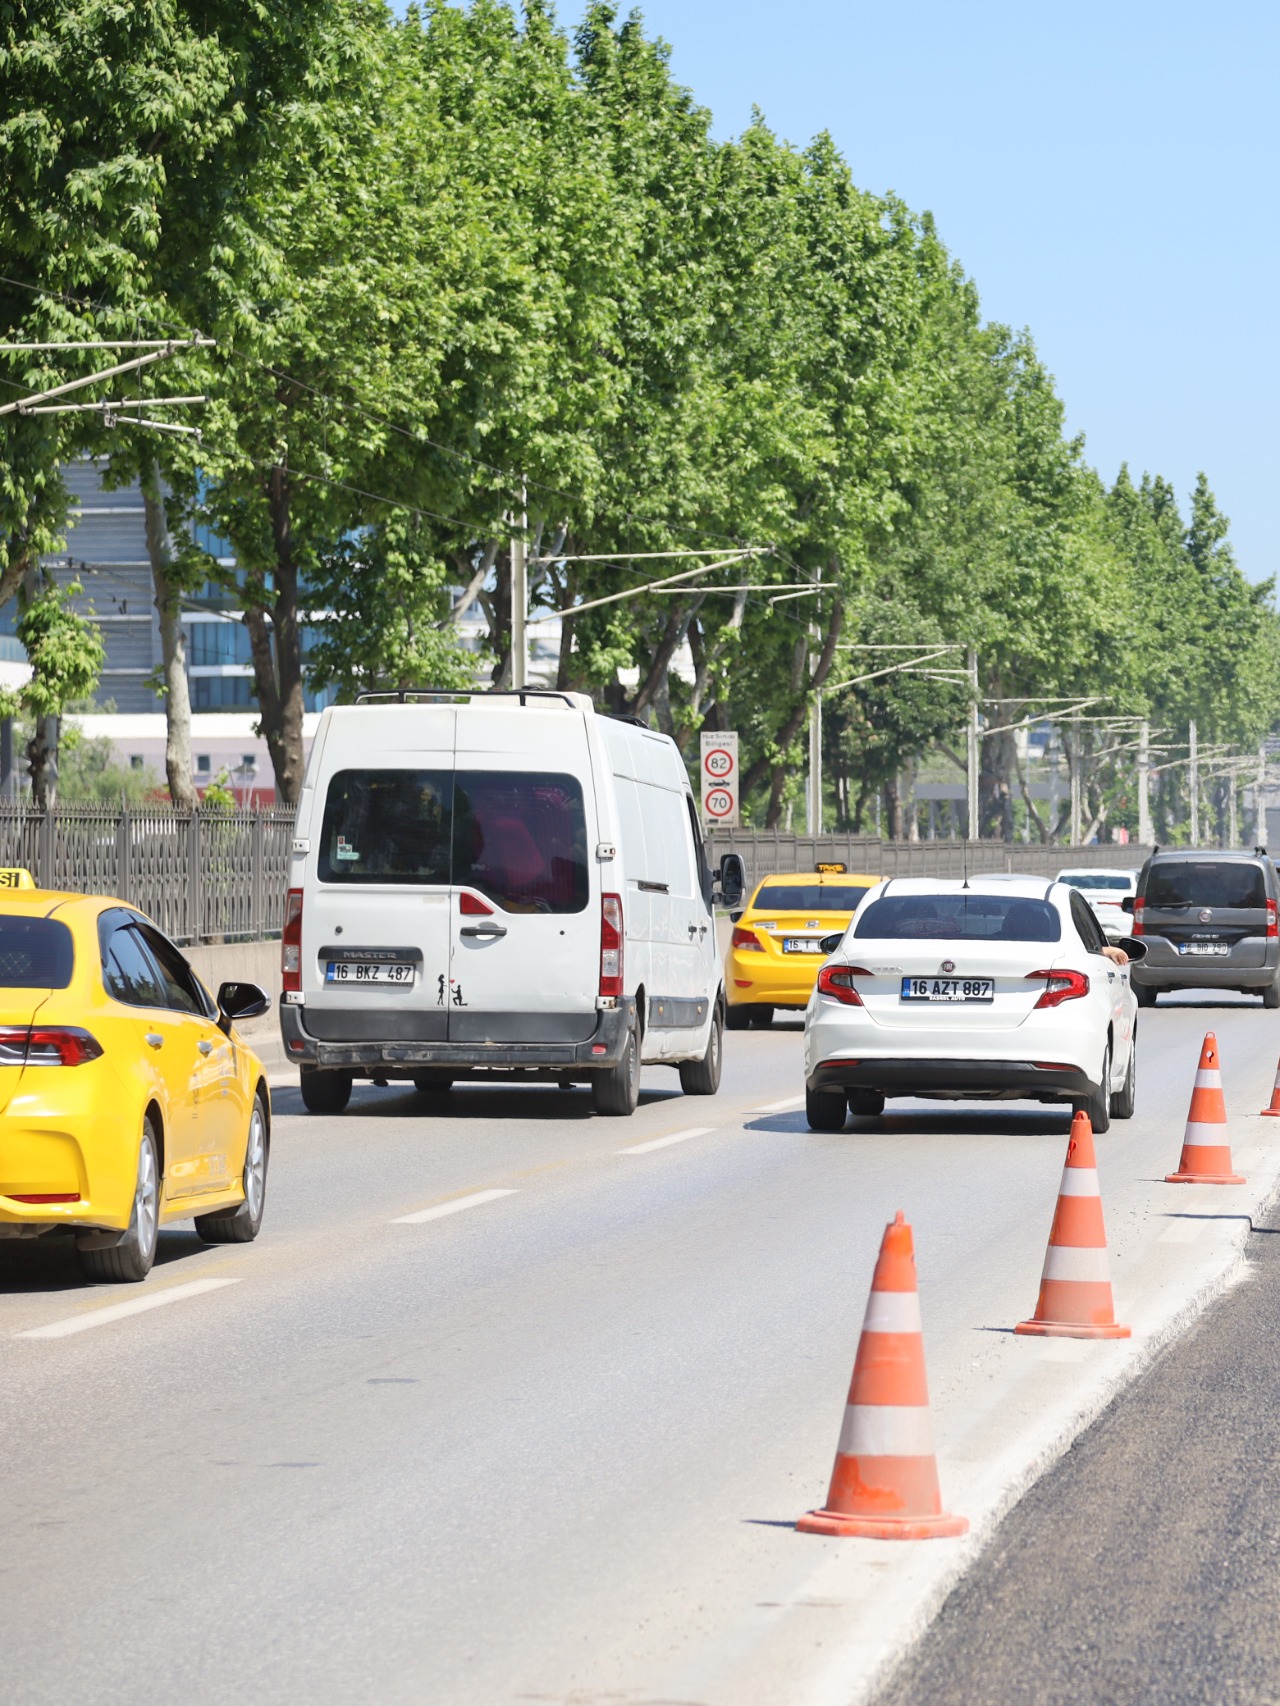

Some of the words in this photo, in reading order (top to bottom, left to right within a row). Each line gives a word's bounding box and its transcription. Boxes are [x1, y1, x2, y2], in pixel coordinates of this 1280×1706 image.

[711, 757, 727, 769] 82
[711, 797, 727, 809] 70
[789, 940, 798, 949] 16
[343, 951, 397, 959] MASTER
[336, 964, 348, 979] 16
[356, 965, 380, 980] BKZ
[387, 966, 412, 981] 487
[912, 980, 928, 995] 16
[932, 981, 960, 995] AZT
[962, 982, 990, 996] 887
